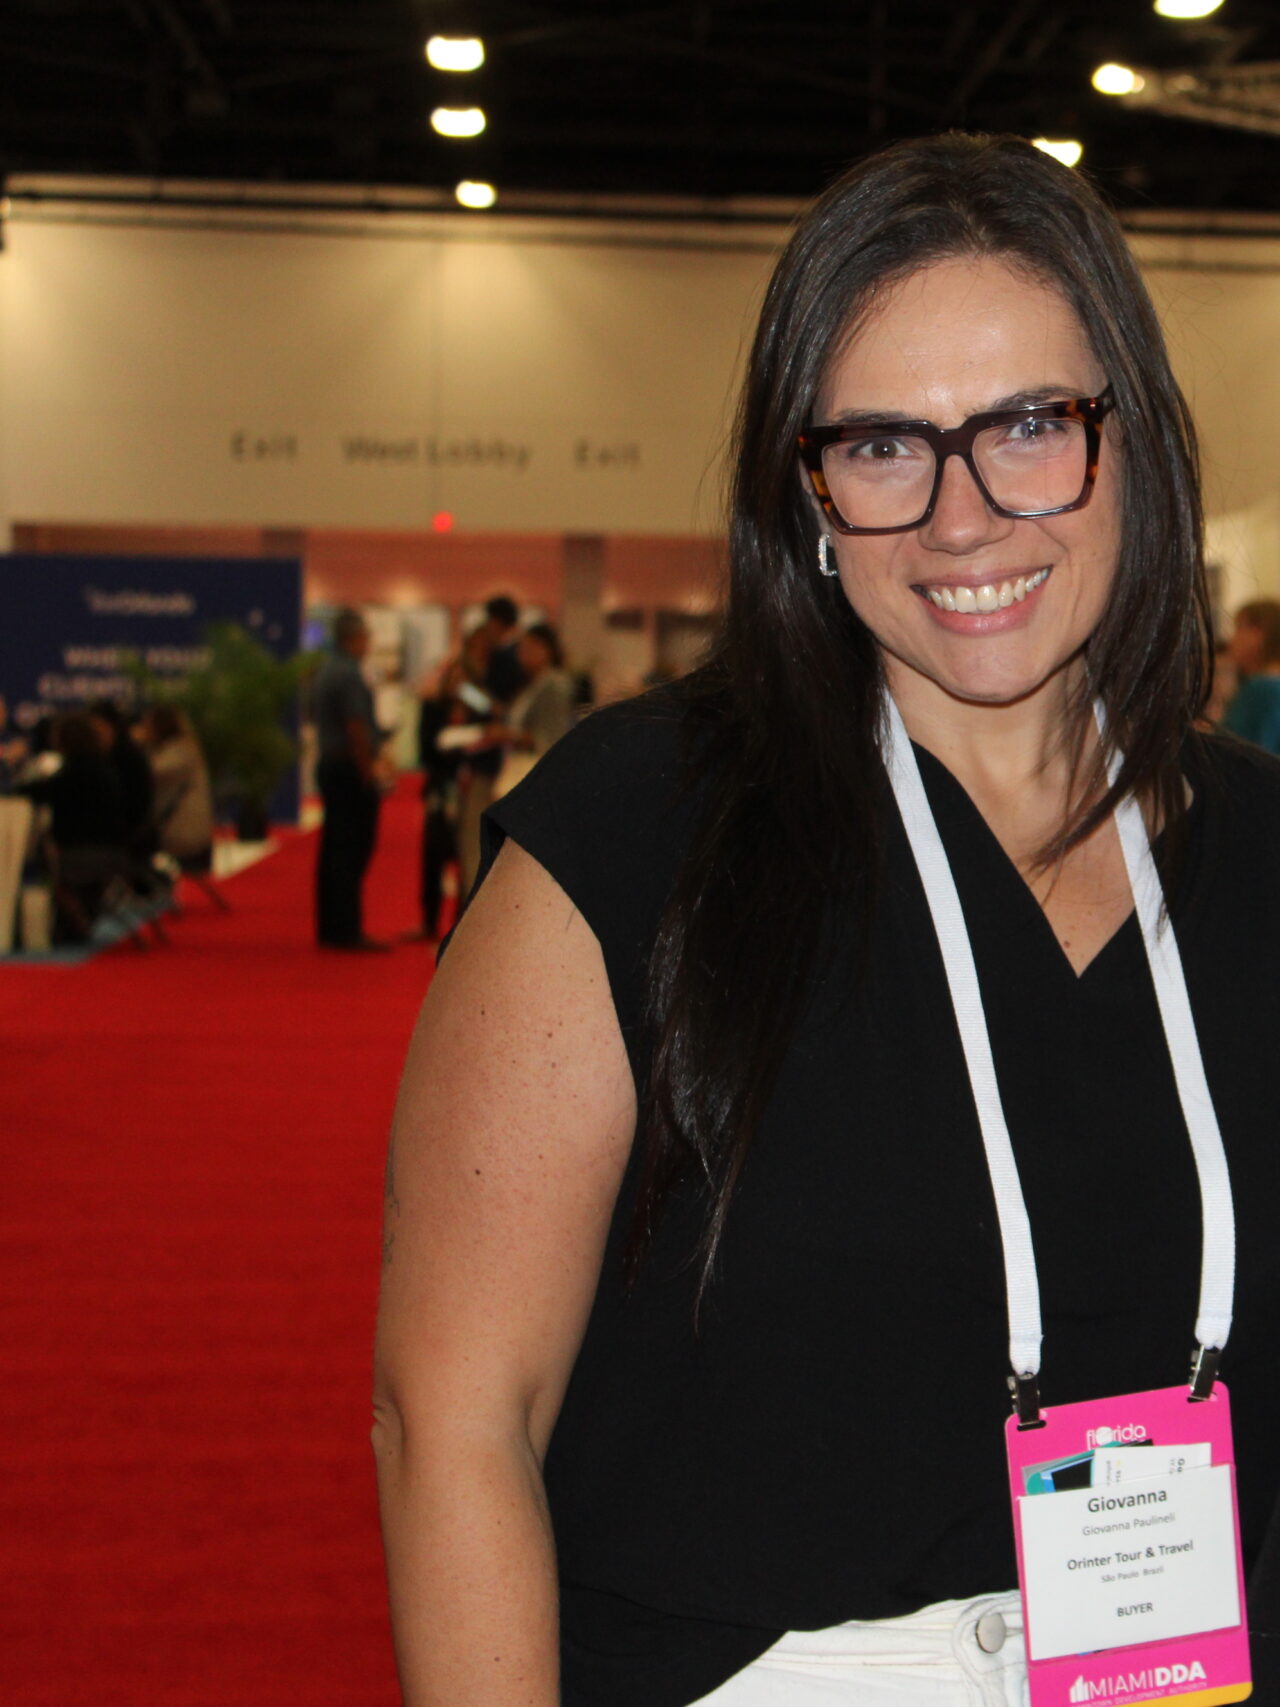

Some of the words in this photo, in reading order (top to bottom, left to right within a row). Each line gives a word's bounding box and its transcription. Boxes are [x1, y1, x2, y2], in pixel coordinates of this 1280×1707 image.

[1087, 1489, 1168, 1513] Giovanna
[1082, 1522, 1131, 1536] Giovanna
[1067, 1556, 1112, 1571] Orinter
[1115, 1552, 1142, 1564] Tour
[1145, 1546, 1155, 1559] &
[1158, 1540, 1194, 1557] Travel
[1116, 1602, 1154, 1618] BUYER
